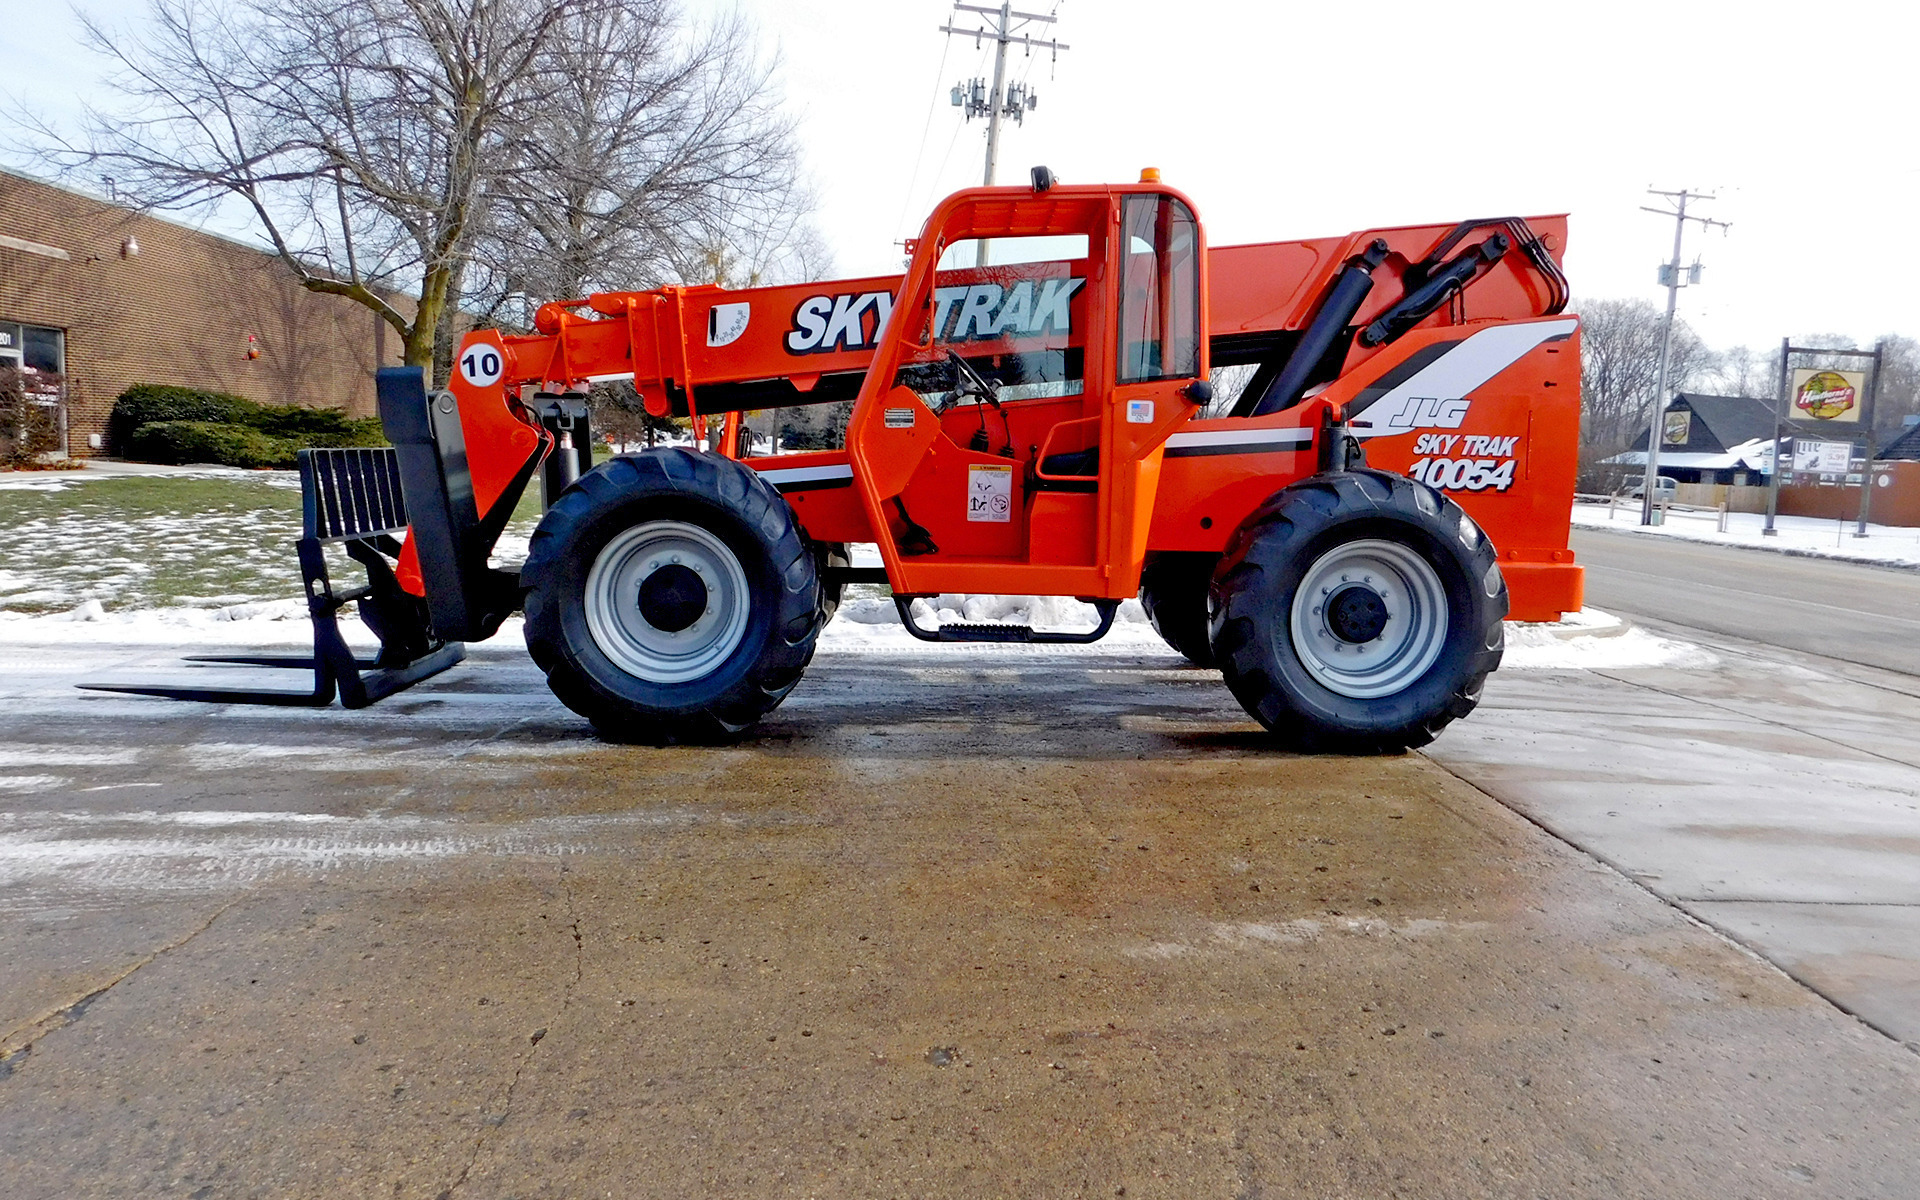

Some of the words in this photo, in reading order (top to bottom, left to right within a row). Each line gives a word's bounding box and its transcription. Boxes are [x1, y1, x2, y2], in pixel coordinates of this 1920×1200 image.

[934, 277, 1087, 339] TRAK
[462, 353, 500, 378] 10
[1388, 397, 1472, 429] JLG
[1412, 433, 1462, 456] SKY
[1460, 434, 1521, 457] TRAK
[1408, 457, 1519, 492] 10054
